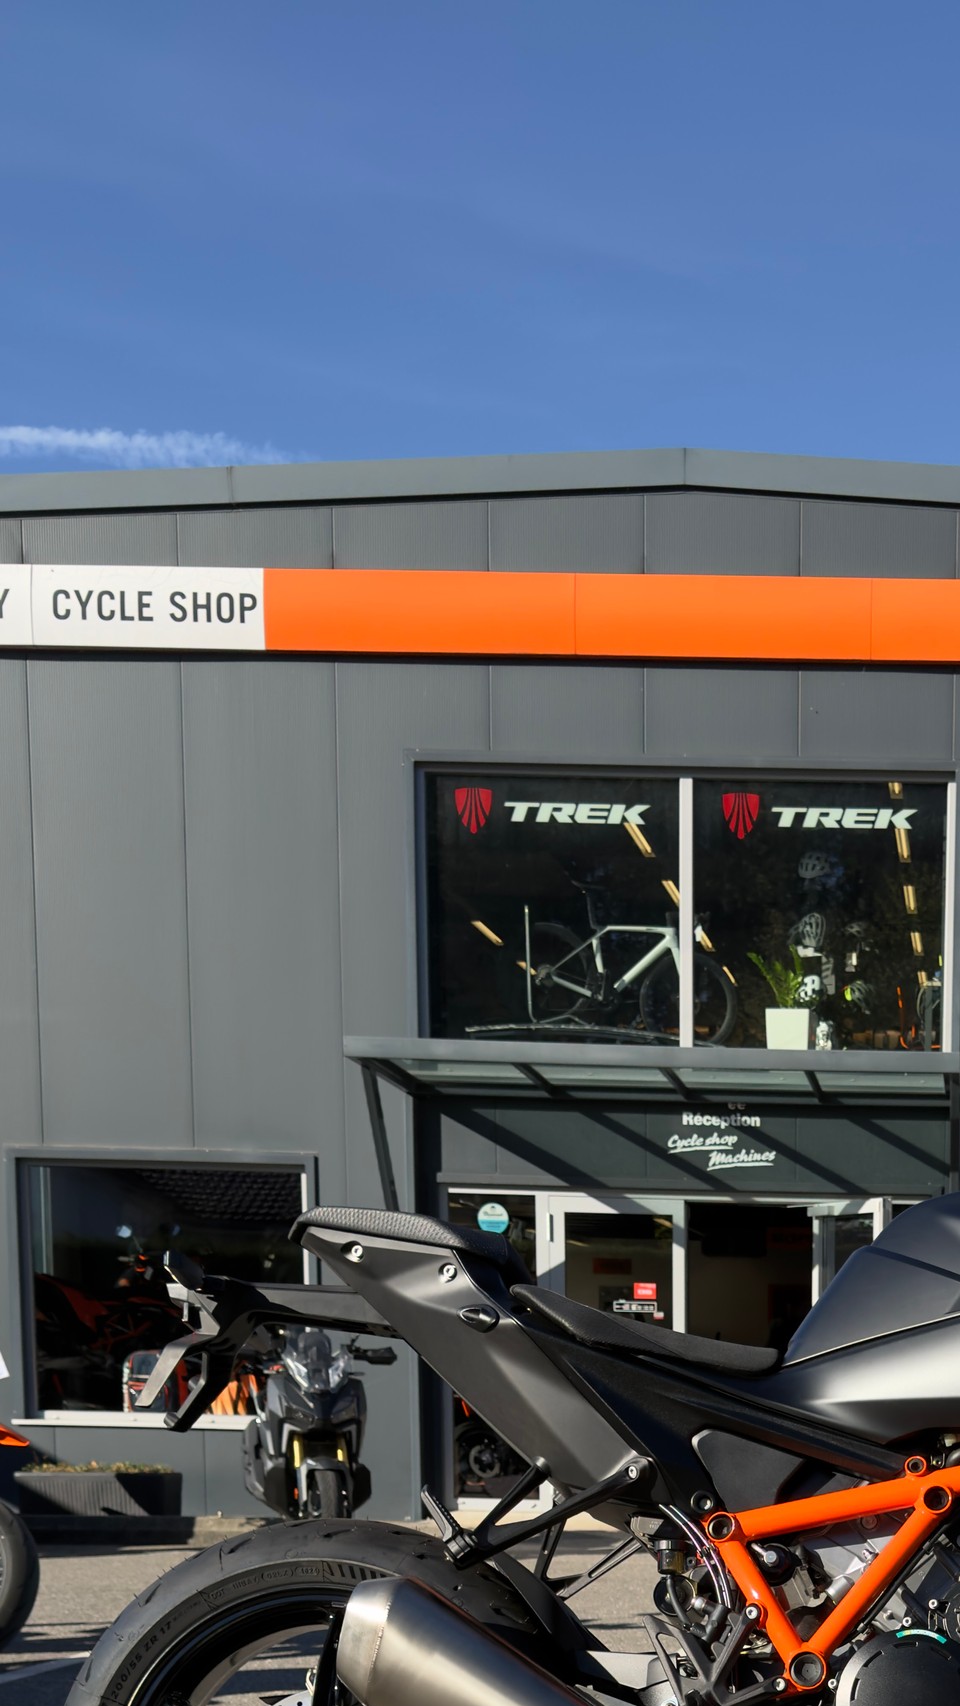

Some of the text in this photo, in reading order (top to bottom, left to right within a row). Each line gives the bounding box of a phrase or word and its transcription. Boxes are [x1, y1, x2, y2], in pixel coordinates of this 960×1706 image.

[52, 589, 154, 622] CYCLE
[169, 591, 257, 624] SHOP
[504, 801, 651, 825] TREK
[771, 806, 918, 830] TREK
[681, 1111, 761, 1129] Réception
[667, 1132, 738, 1149] Cycle shop
[708, 1149, 776, 1167] Machines
